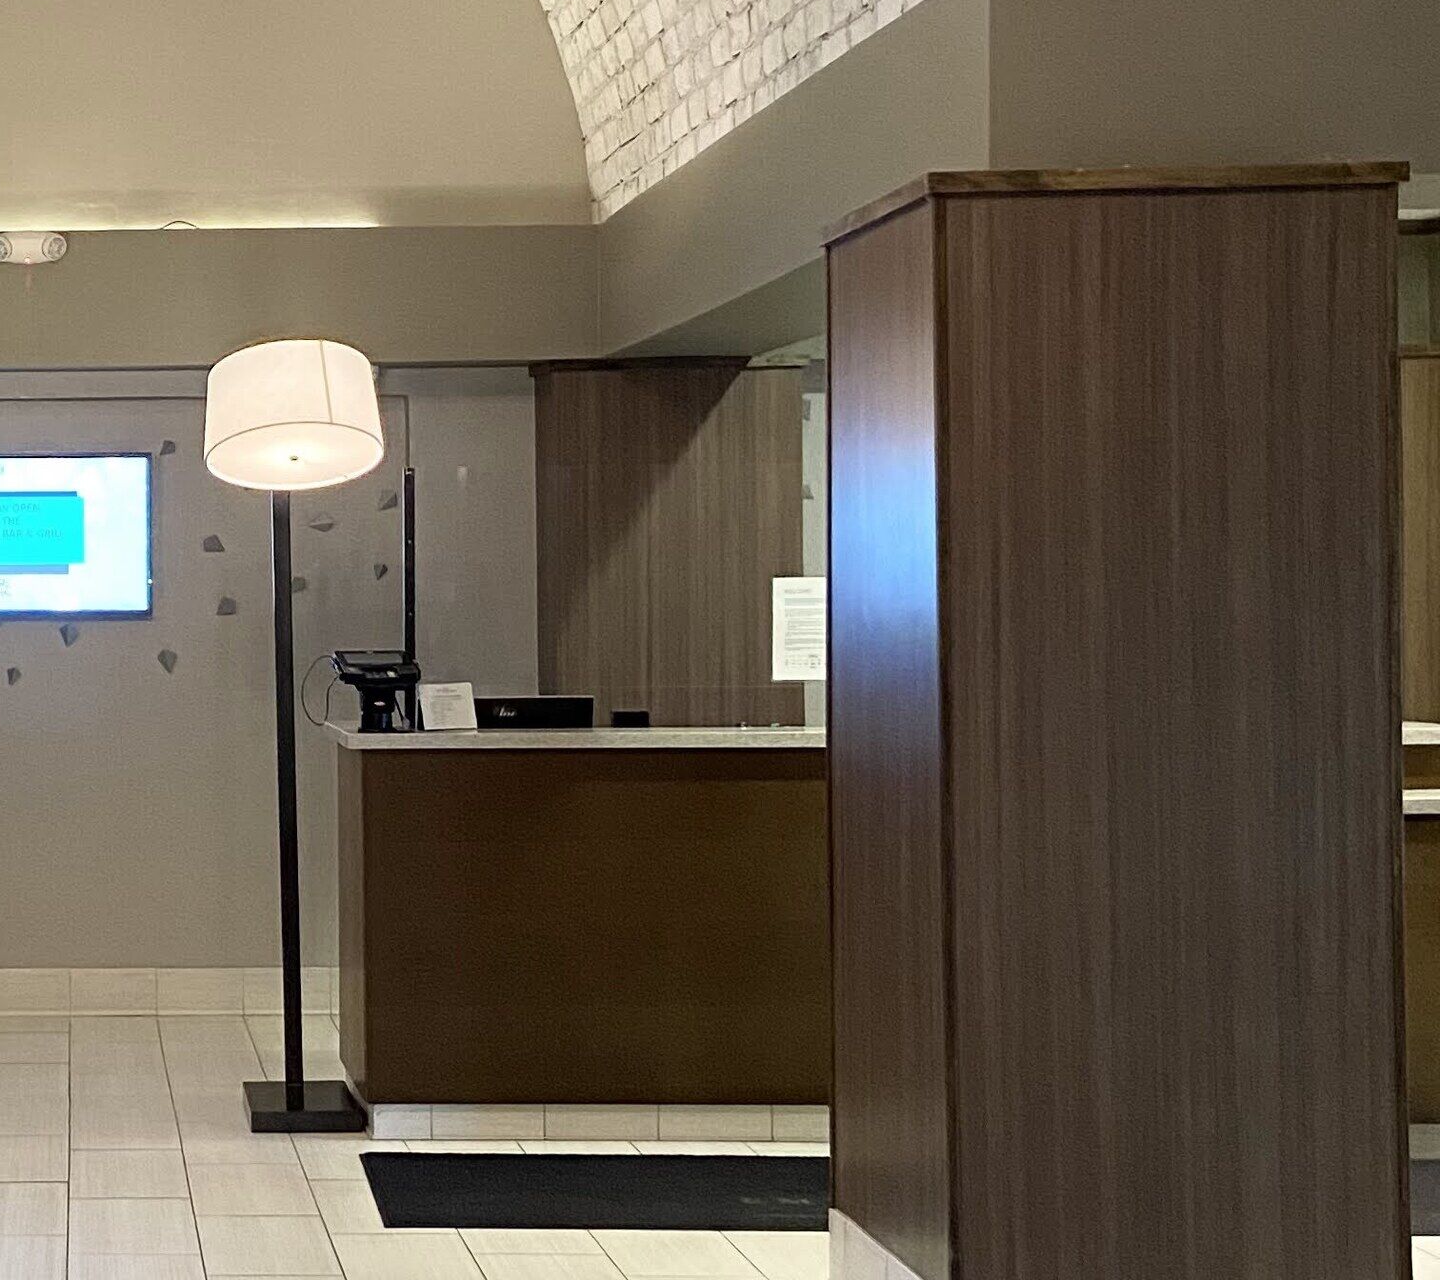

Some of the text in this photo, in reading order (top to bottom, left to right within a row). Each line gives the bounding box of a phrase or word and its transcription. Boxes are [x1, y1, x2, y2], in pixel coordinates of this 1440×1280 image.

[12, 503, 40, 513] OPEN
[2, 516, 19, 526] THE
[3, 529, 22, 539] BAR
